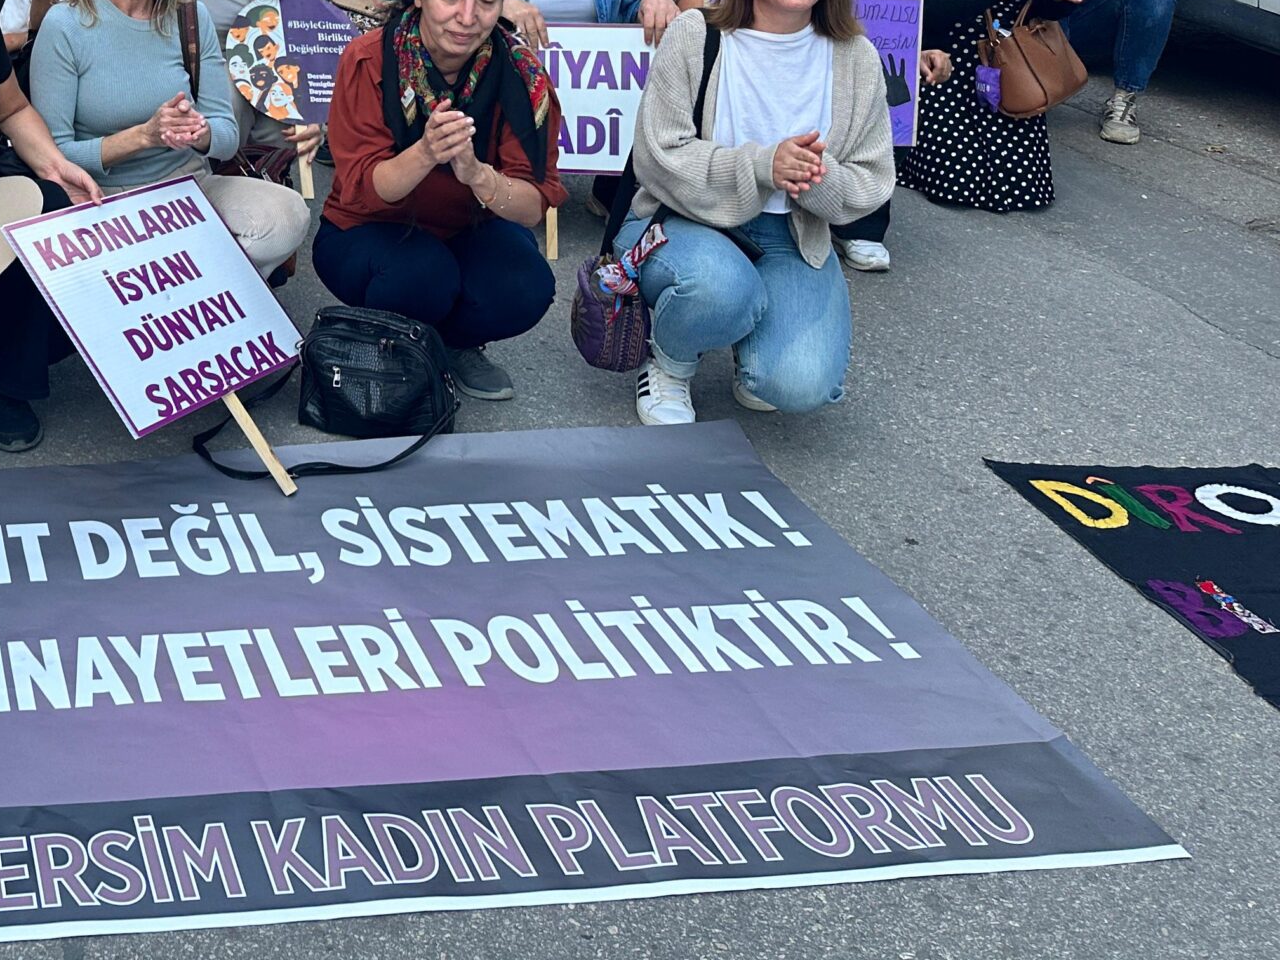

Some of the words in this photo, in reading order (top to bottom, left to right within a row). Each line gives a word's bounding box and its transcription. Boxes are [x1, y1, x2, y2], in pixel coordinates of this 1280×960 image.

[288, 20, 351, 31] #BöyleGitmez
[288, 44, 345, 55] Değiştireceğ
[318, 33, 352, 42] Birlikte
[557, 108, 624, 156] ADÎ
[32, 195, 206, 271] KADINLARIN
[102, 250, 203, 306] İSYANI
[123, 290, 247, 362] DÜNYAYI
[144, 331, 289, 418] SARSACAK
[68, 502, 325, 583] DEĞİL,
[250, 805, 533, 896] KADIN
[524, 773, 1036, 877] PLATFORMU
